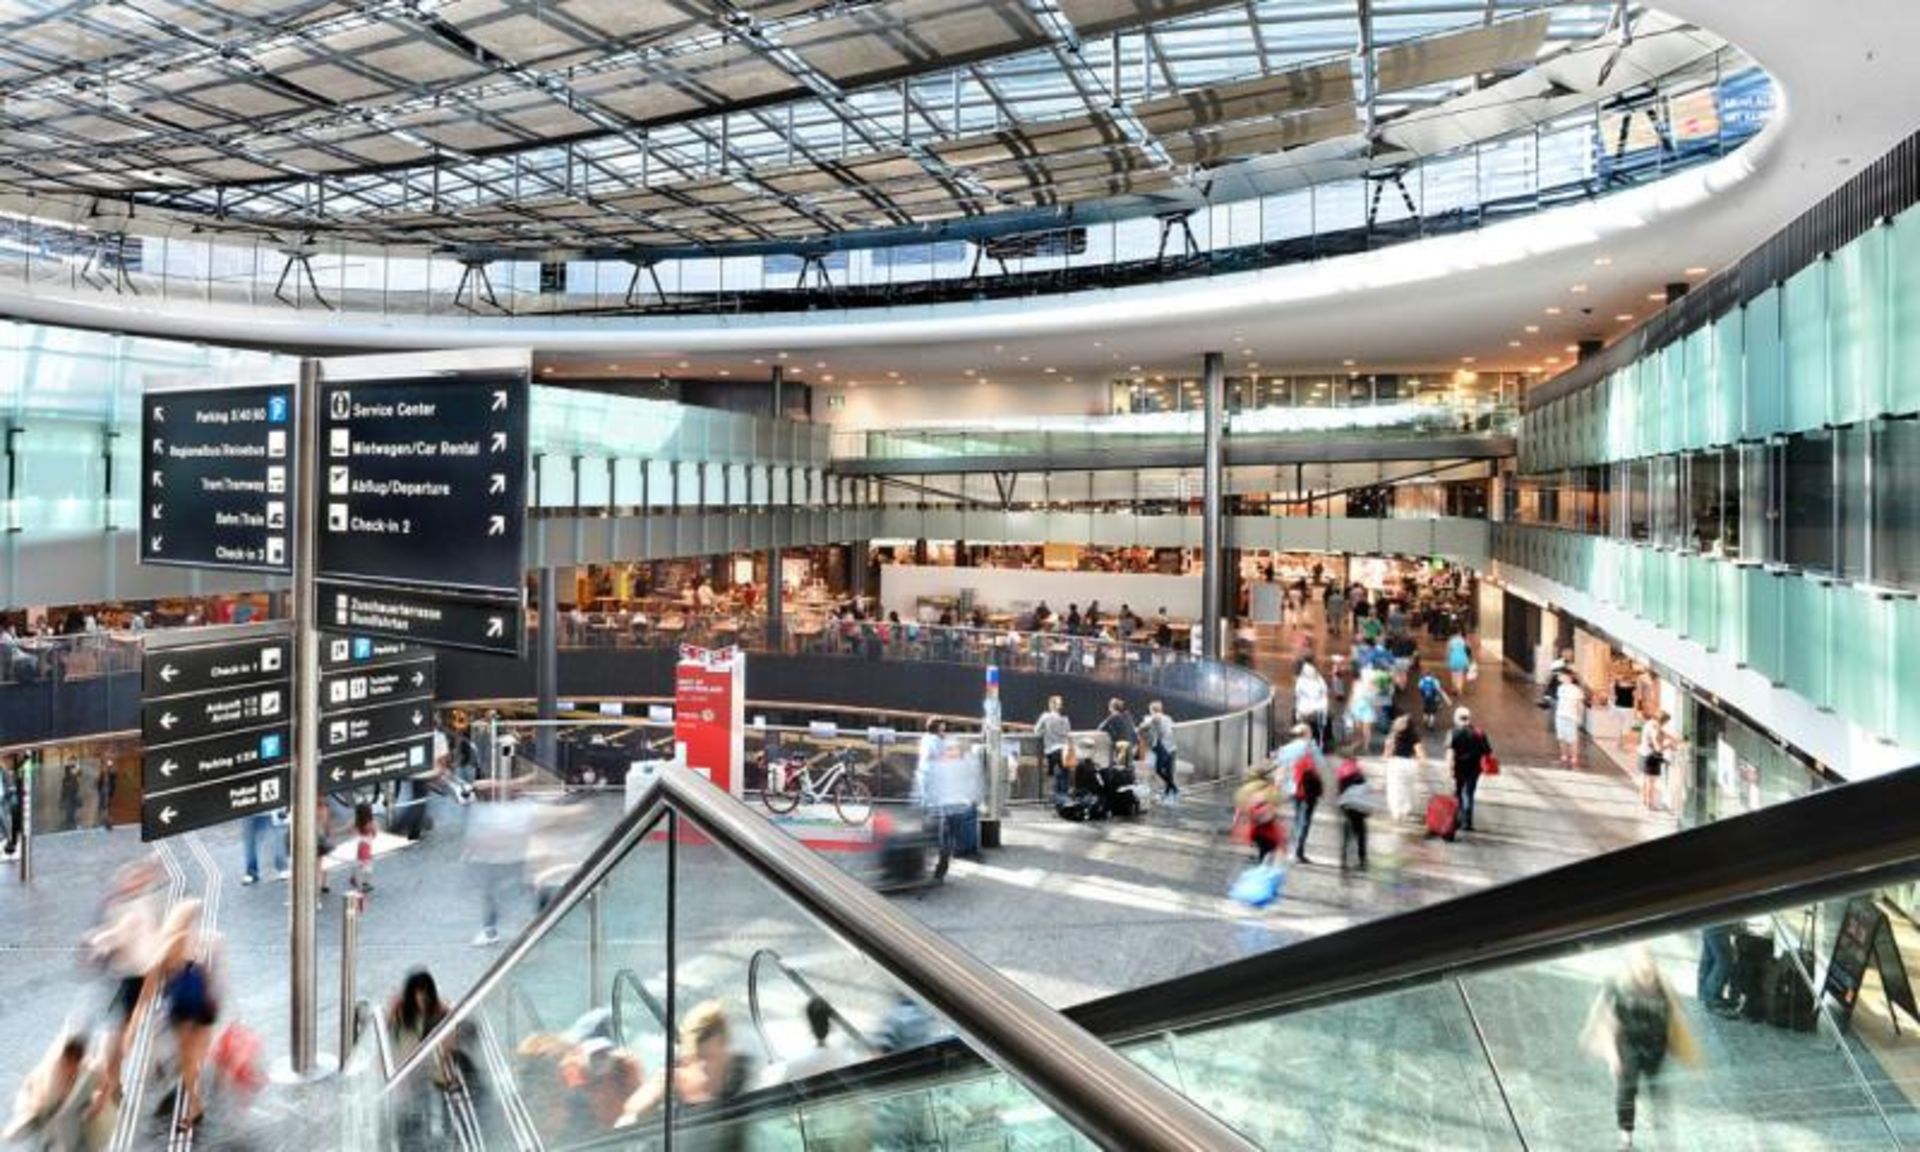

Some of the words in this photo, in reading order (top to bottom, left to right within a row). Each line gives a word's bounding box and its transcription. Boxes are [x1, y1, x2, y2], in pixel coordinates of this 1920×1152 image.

[352, 404, 394, 417] Service
[397, 402, 436, 416] Center
[196, 411, 228, 424] Parking
[352, 441, 437, 457] Mietwagen/Car
[440, 441, 480, 455] Rental
[352, 479, 450, 496] Abflug/Departure
[350, 517, 399, 533] Check-in
[402, 519, 411, 533] 2
[215, 546, 256, 560] Check-in
